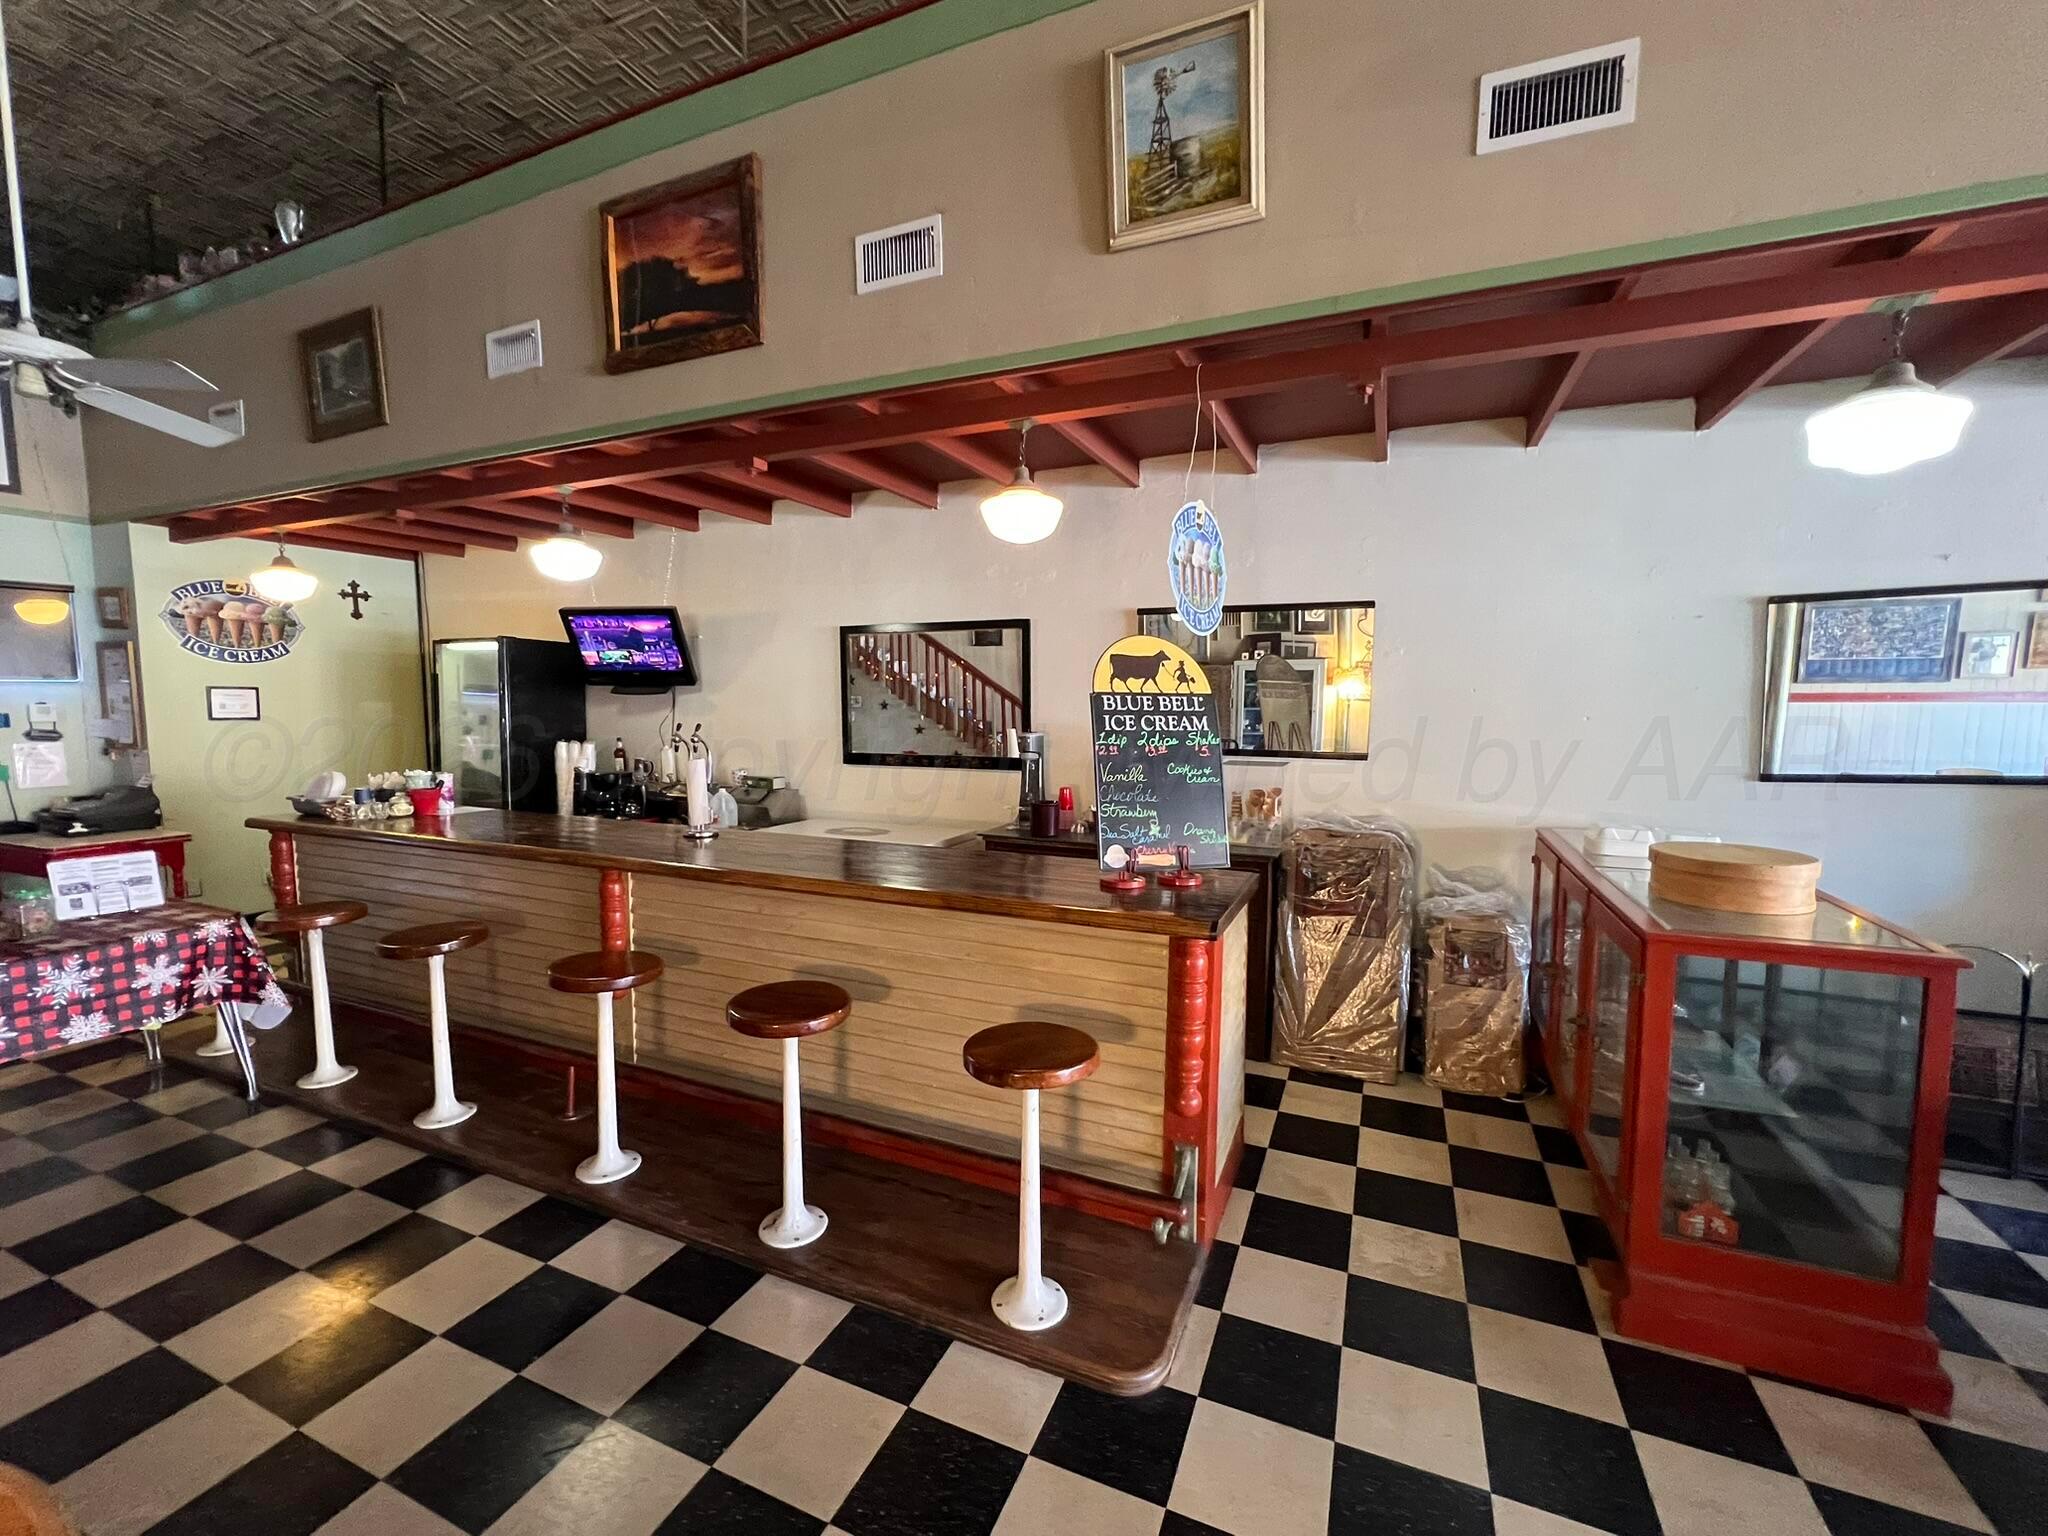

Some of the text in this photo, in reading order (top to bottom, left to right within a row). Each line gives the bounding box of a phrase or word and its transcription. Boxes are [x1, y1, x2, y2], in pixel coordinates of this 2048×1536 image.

[176, 581, 222, 601] BLUE
[185, 637, 287, 662] ICE CREAM
[1102, 695, 1205, 711] BLUE BELL
[1103, 715, 1209, 731] ICE CREAM
[1100, 762, 1148, 783] Vanilla
